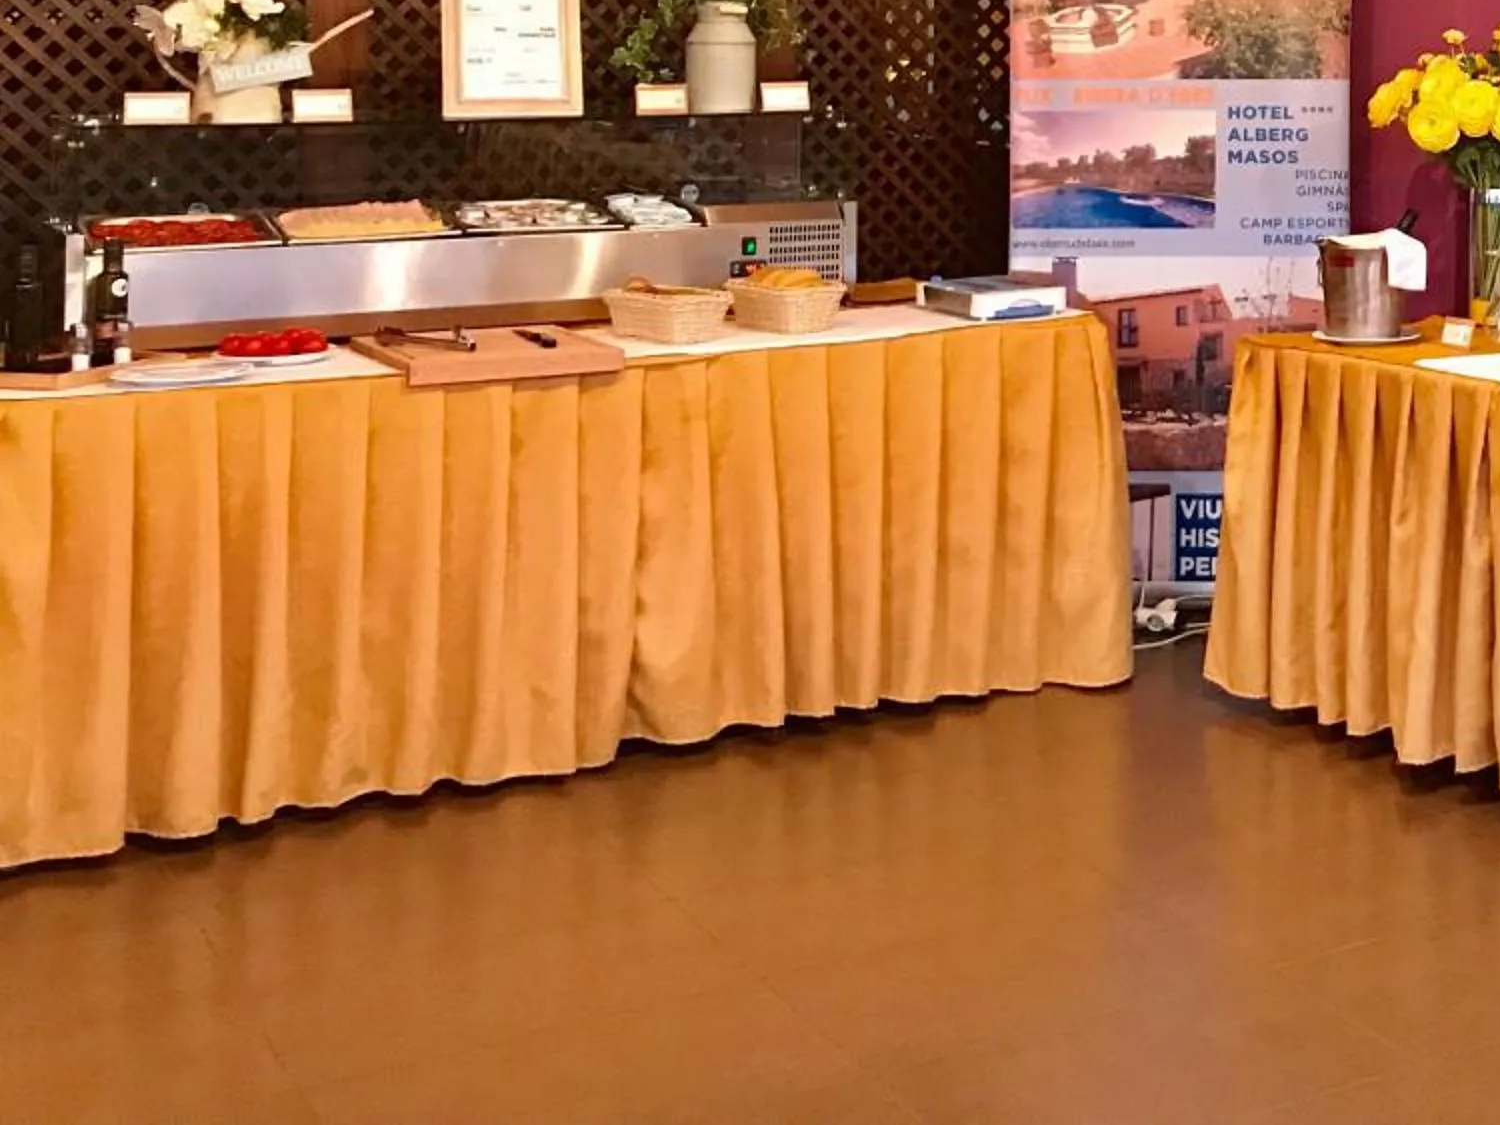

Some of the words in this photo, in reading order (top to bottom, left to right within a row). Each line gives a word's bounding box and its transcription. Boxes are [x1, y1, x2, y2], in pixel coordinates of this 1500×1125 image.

[1227, 105, 1294, 120] HOTEL
[1227, 127, 1309, 142] ALBERG
[1227, 150, 1300, 164] MASOS
[1240, 217, 1283, 229] CAMP
[1263, 234, 1325, 245] BARBAC
[1180, 499, 1223, 520] VIU
[1180, 527, 1219, 548] HIS
